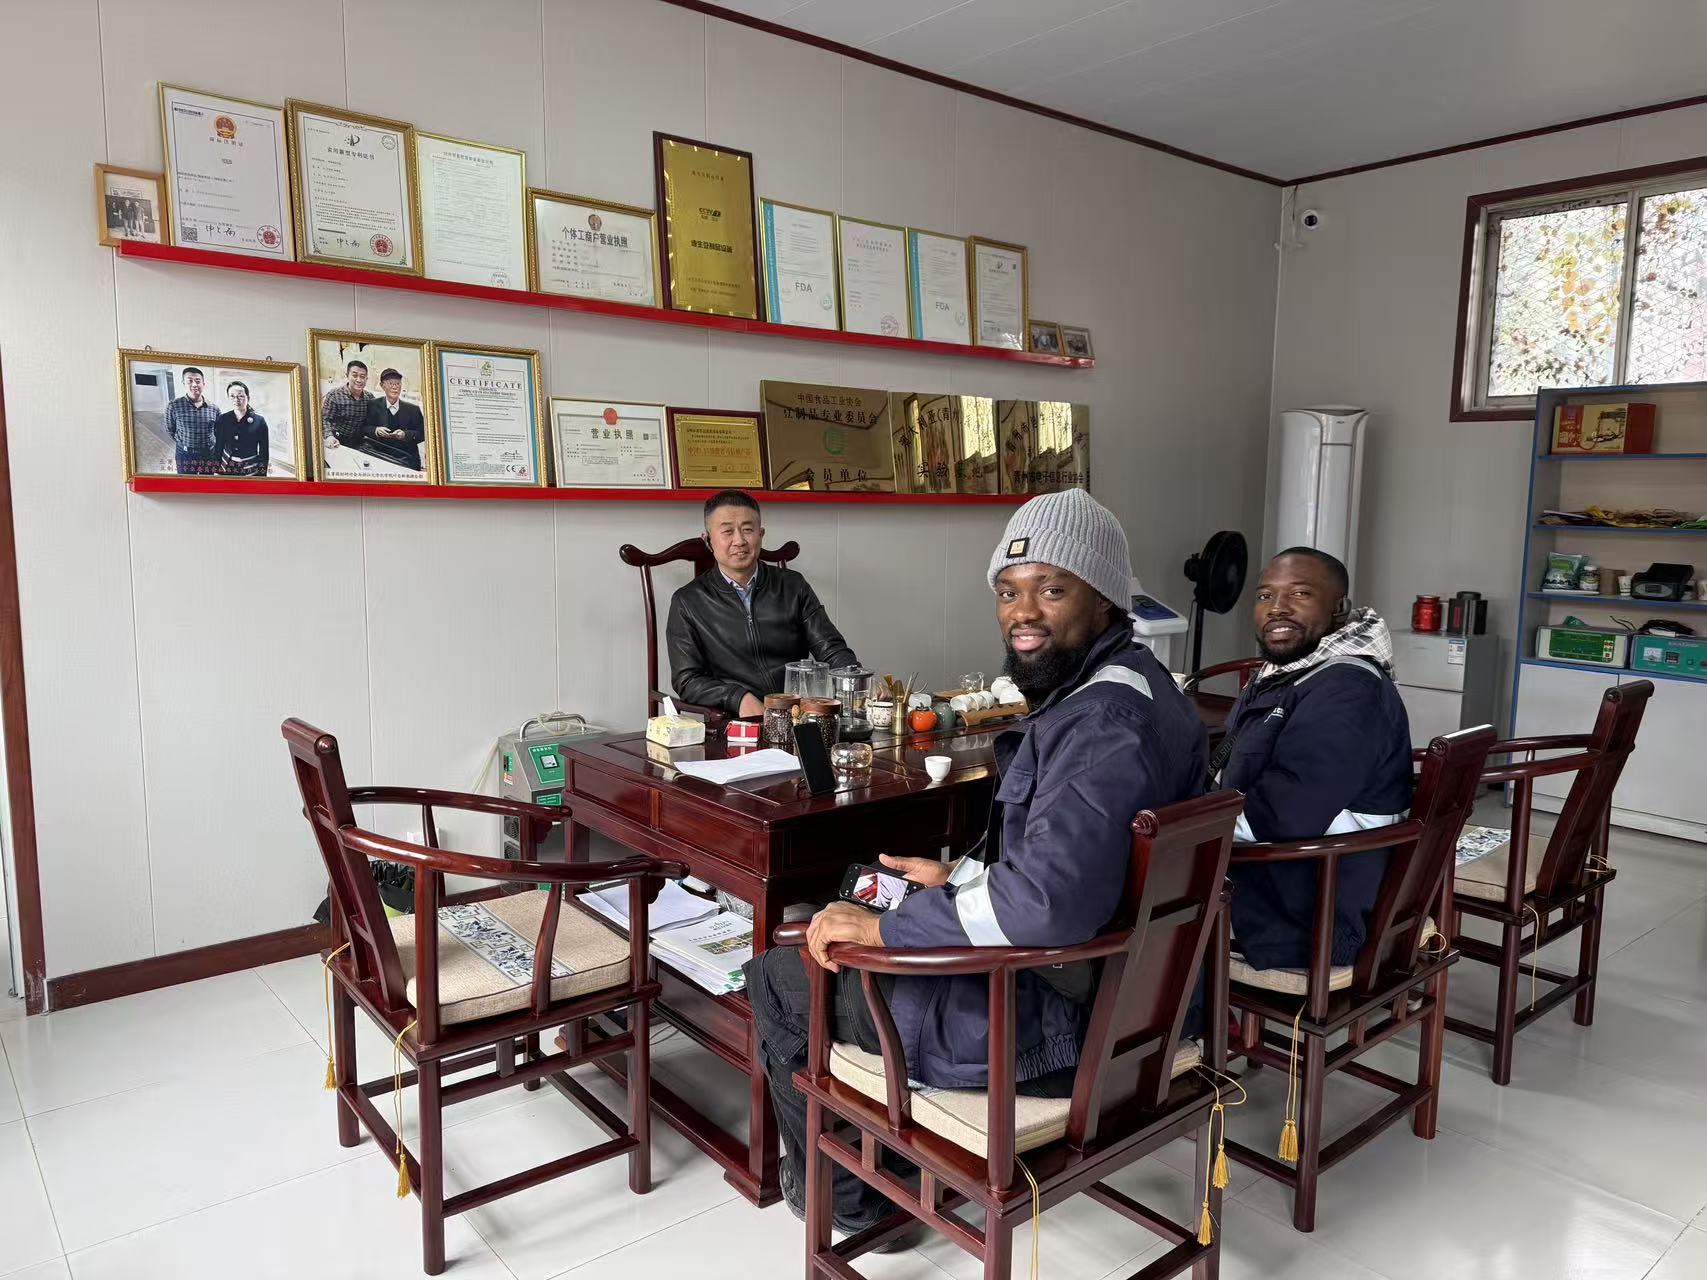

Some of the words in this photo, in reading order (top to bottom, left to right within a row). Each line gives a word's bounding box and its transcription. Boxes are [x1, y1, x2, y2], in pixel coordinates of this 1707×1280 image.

[562, 226, 628, 248] 个体工商户营业执照
[795, 282, 813, 293] FDA
[935, 301, 950, 311] FDA
[449, 377, 522, 389] CERTIFICATE
[798, 393, 862, 407] 中国食品工业协会
[783, 407, 877, 425] 豆制品专业委员会
[591, 428, 633, 440] 营业执照
[506, 465, 516, 473] CE
[807, 467, 867, 482] 会员单位
